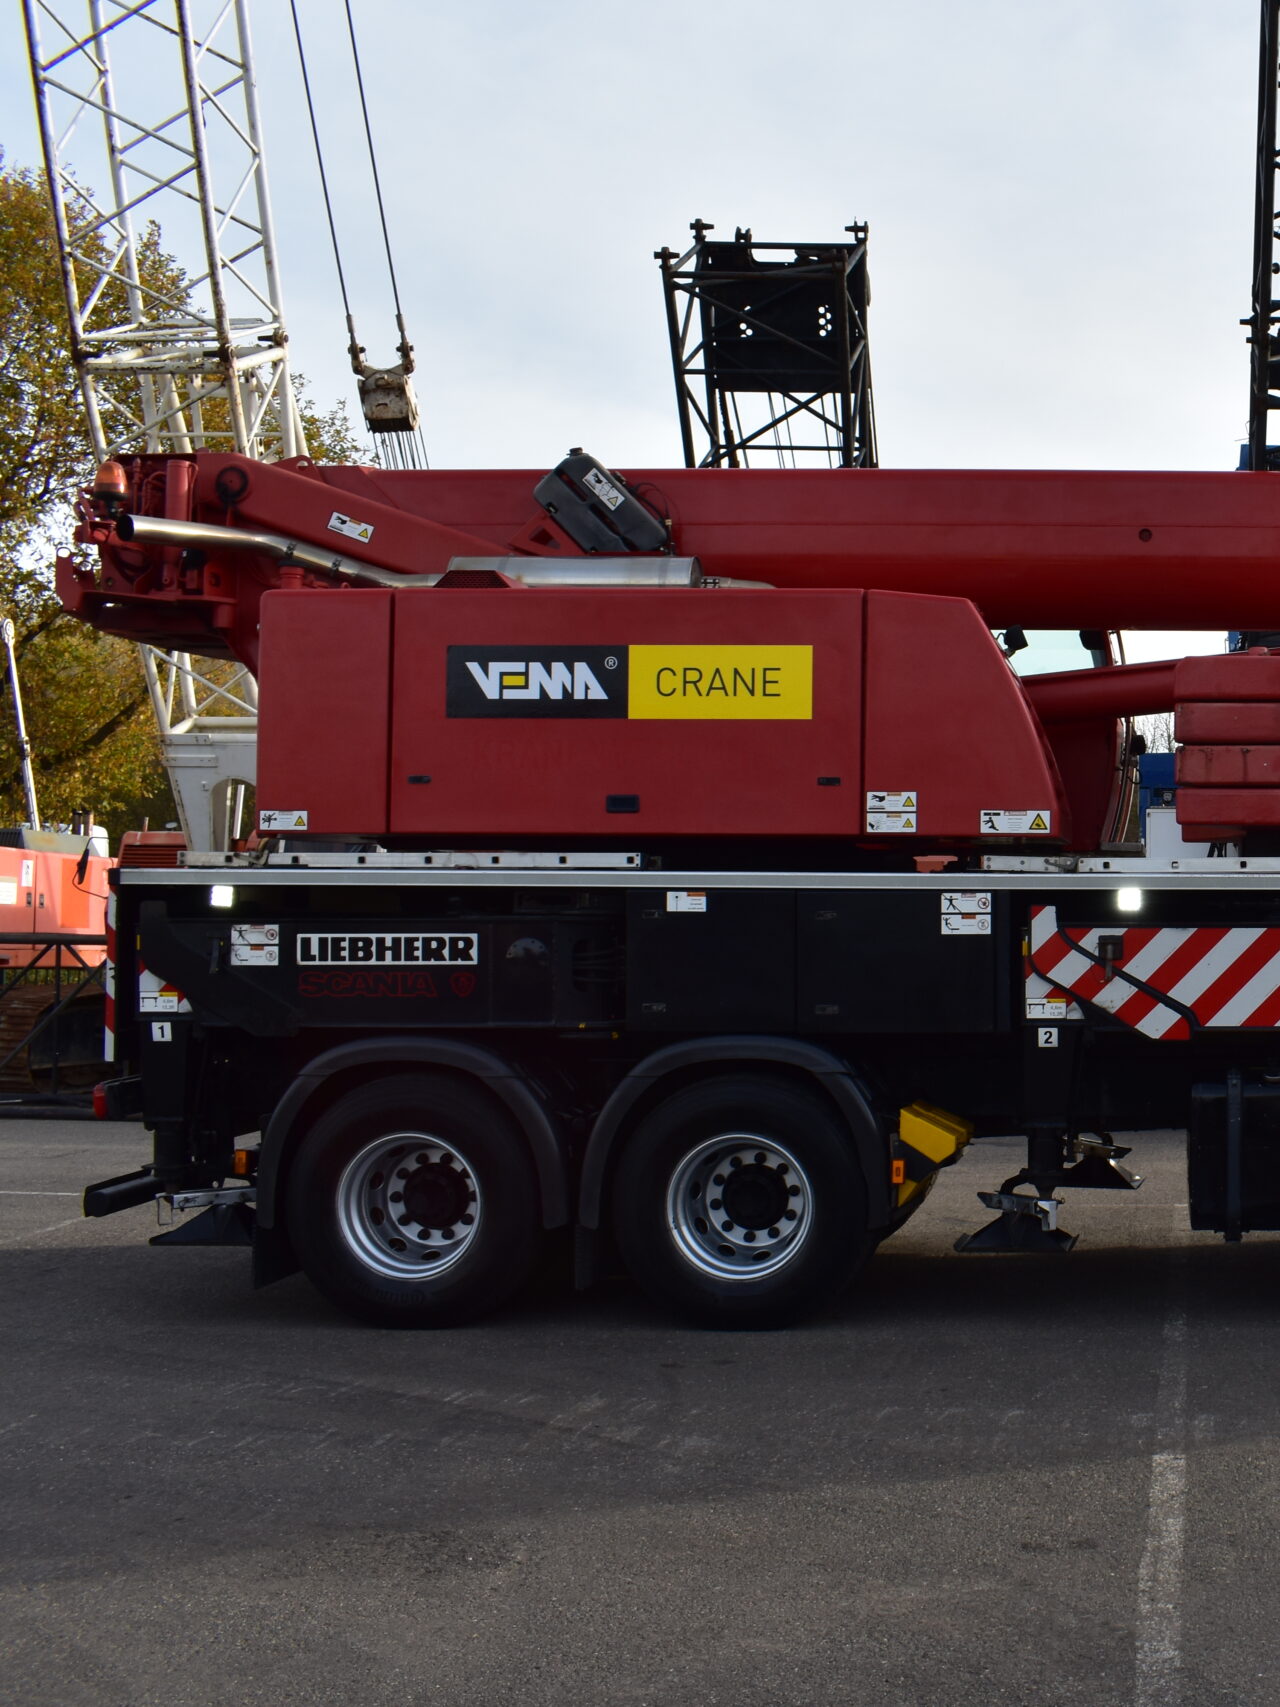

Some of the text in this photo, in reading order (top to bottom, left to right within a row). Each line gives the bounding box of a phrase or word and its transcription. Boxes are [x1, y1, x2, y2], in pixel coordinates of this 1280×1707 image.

[655, 667, 782, 698] CRANE
[300, 936, 474, 962] LIEBHERR
[298, 971, 439, 998] SCANIA
[157, 1024, 165, 1039] 1
[1043, 1030, 1053, 1044] 2
